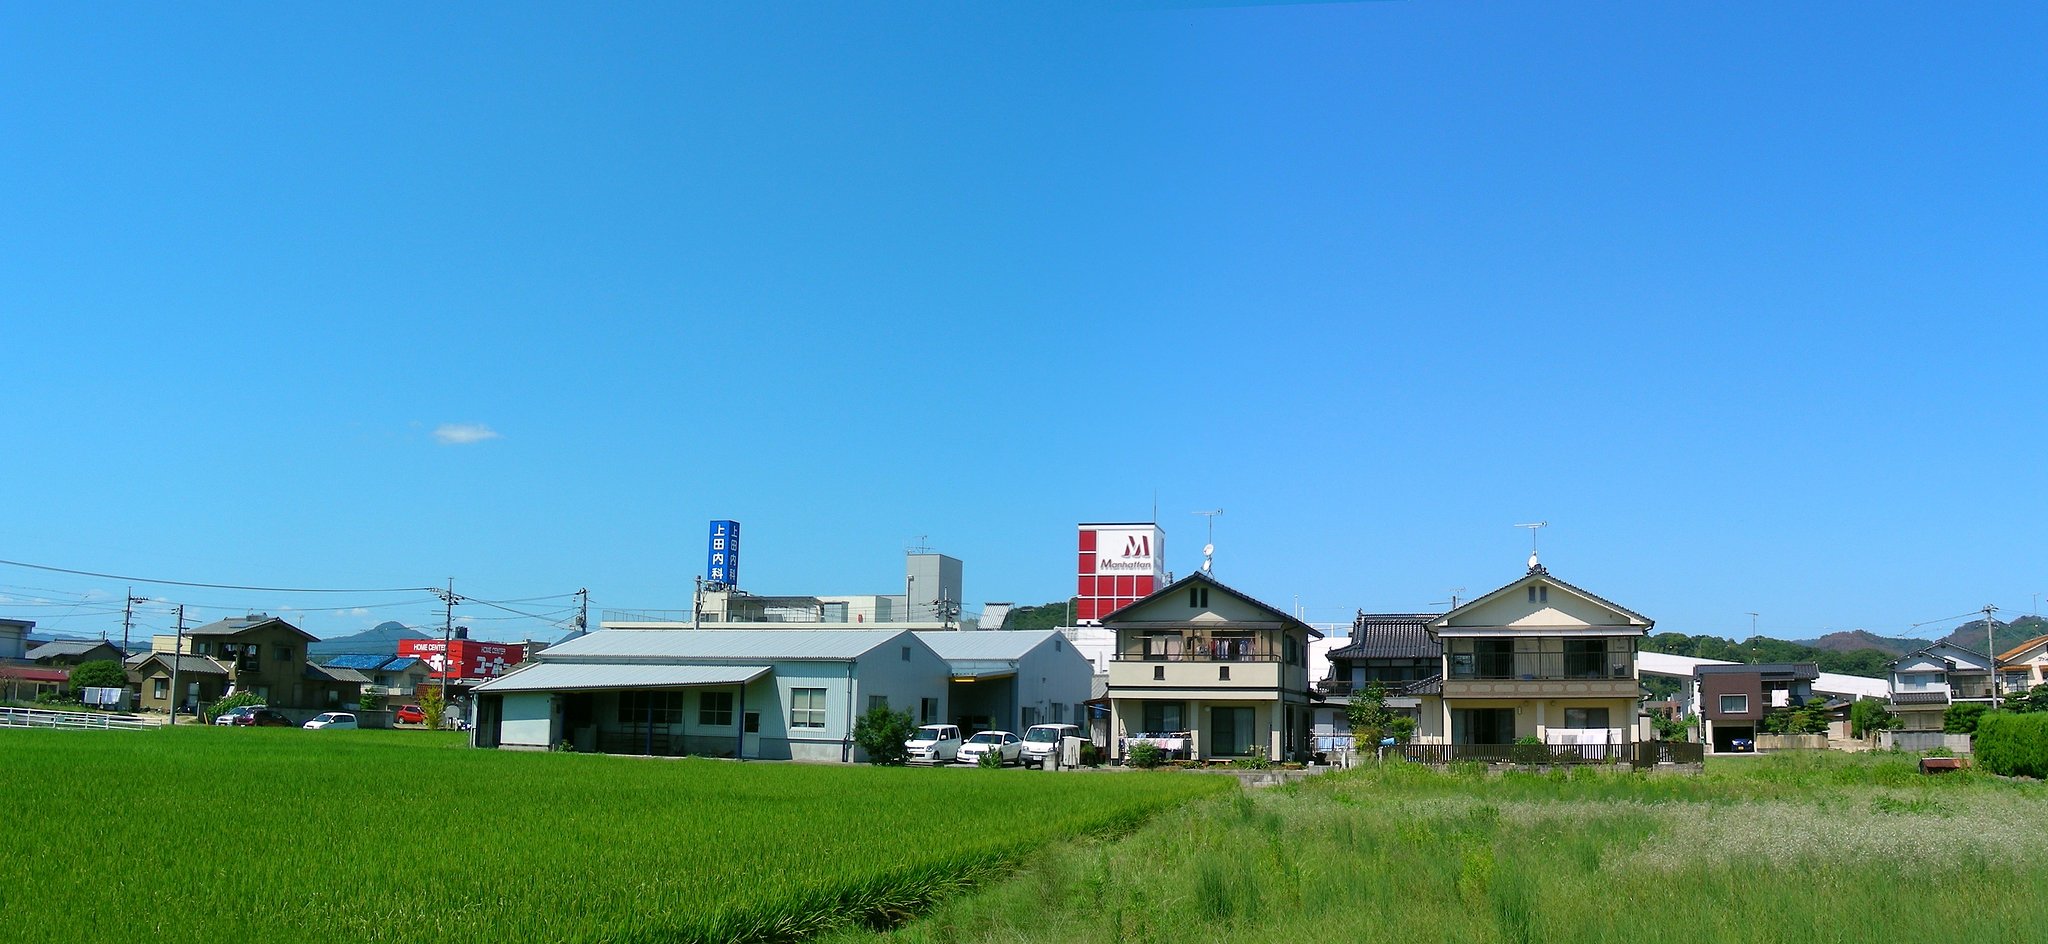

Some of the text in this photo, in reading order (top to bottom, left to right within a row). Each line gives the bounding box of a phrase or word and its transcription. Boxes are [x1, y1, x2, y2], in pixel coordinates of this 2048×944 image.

[711, 524, 725, 580] 上田内科
[1100, 559, 1151, 569] Manhattan
[414, 643, 446, 651] HOME CENTE
[481, 646, 506, 655] HOME CENTER
